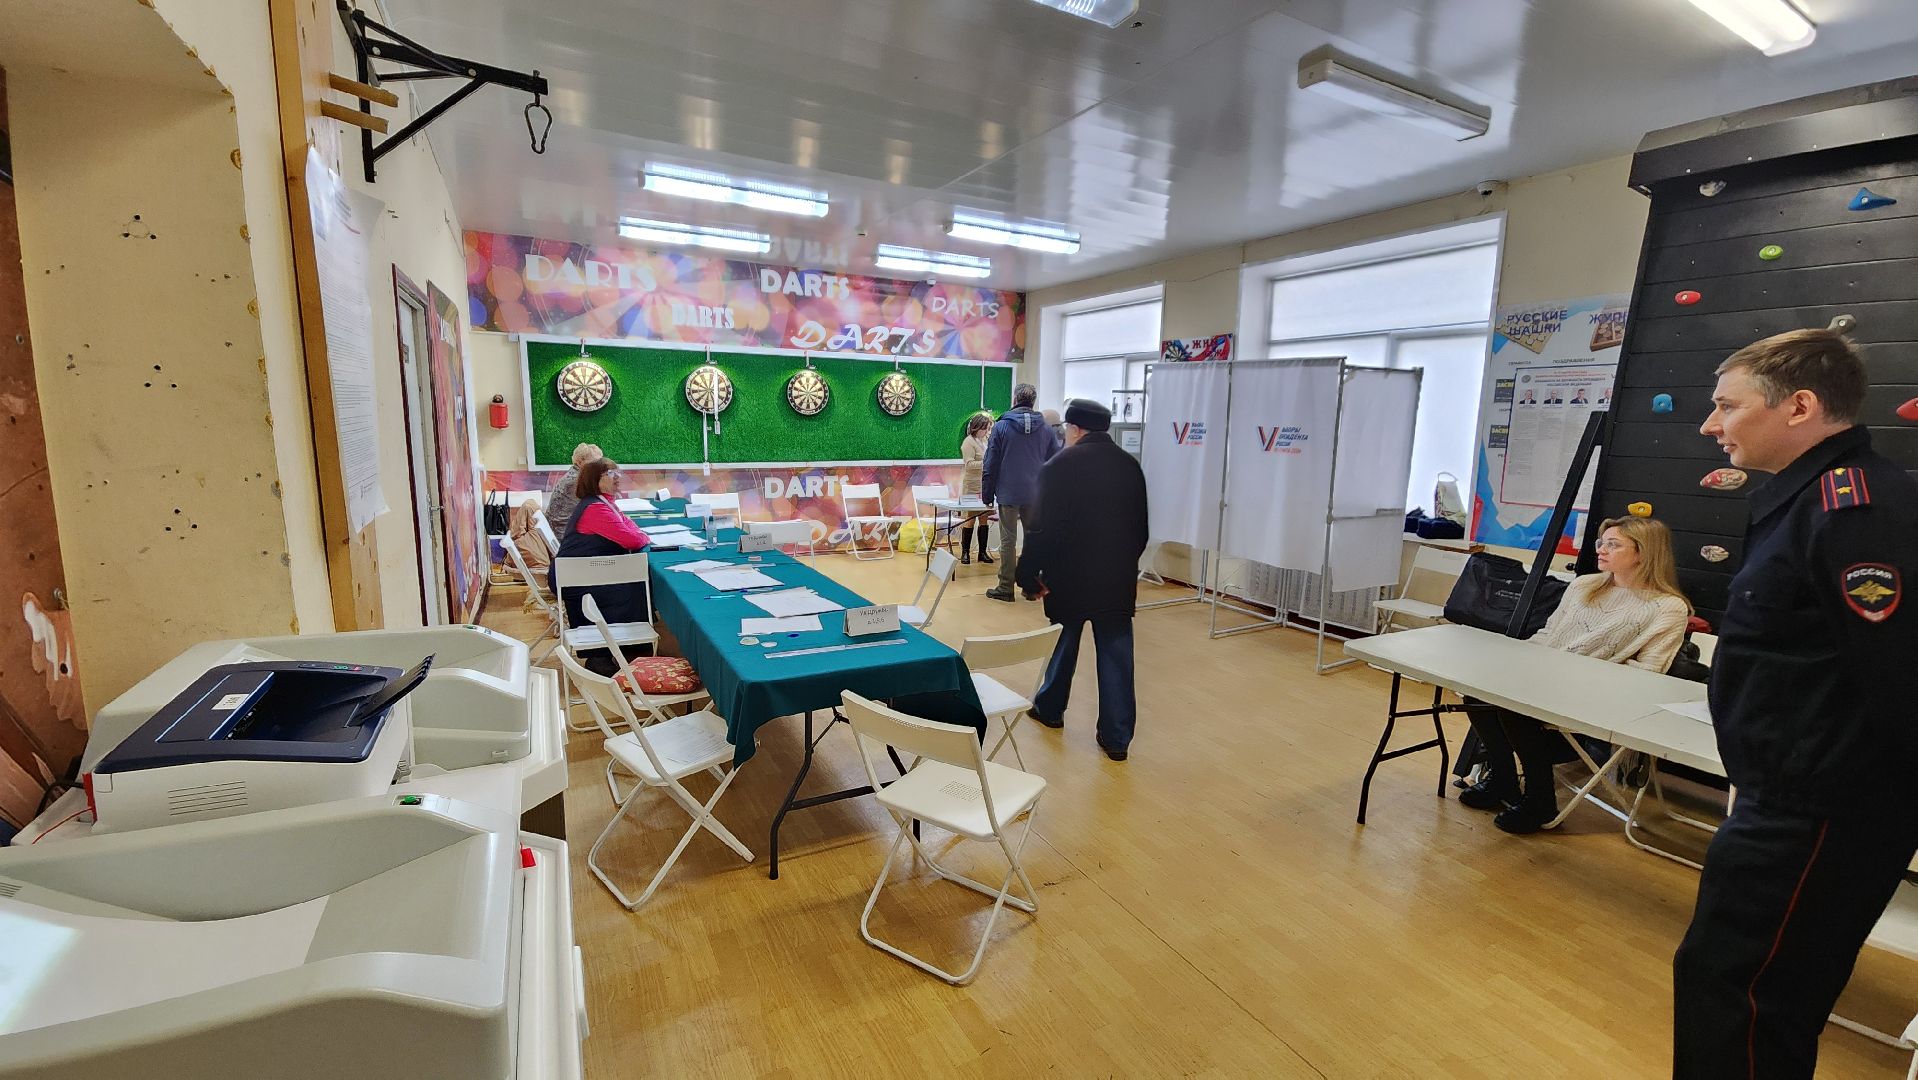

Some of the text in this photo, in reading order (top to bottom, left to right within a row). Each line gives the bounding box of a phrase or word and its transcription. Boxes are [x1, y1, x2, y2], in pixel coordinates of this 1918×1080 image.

[525, 253, 657, 292] DARTS
[760, 268, 850, 300] DARTS
[671, 302, 735, 329] DARTS
[930, 296, 1000, 319] DARTS
[1507, 310, 1568, 325] РУССКИЕ
[790, 320, 936, 354] DARTS
[1508, 322, 1561, 336] ШАШКИ
[1846, 568, 1893, 580] РОССИЯ
